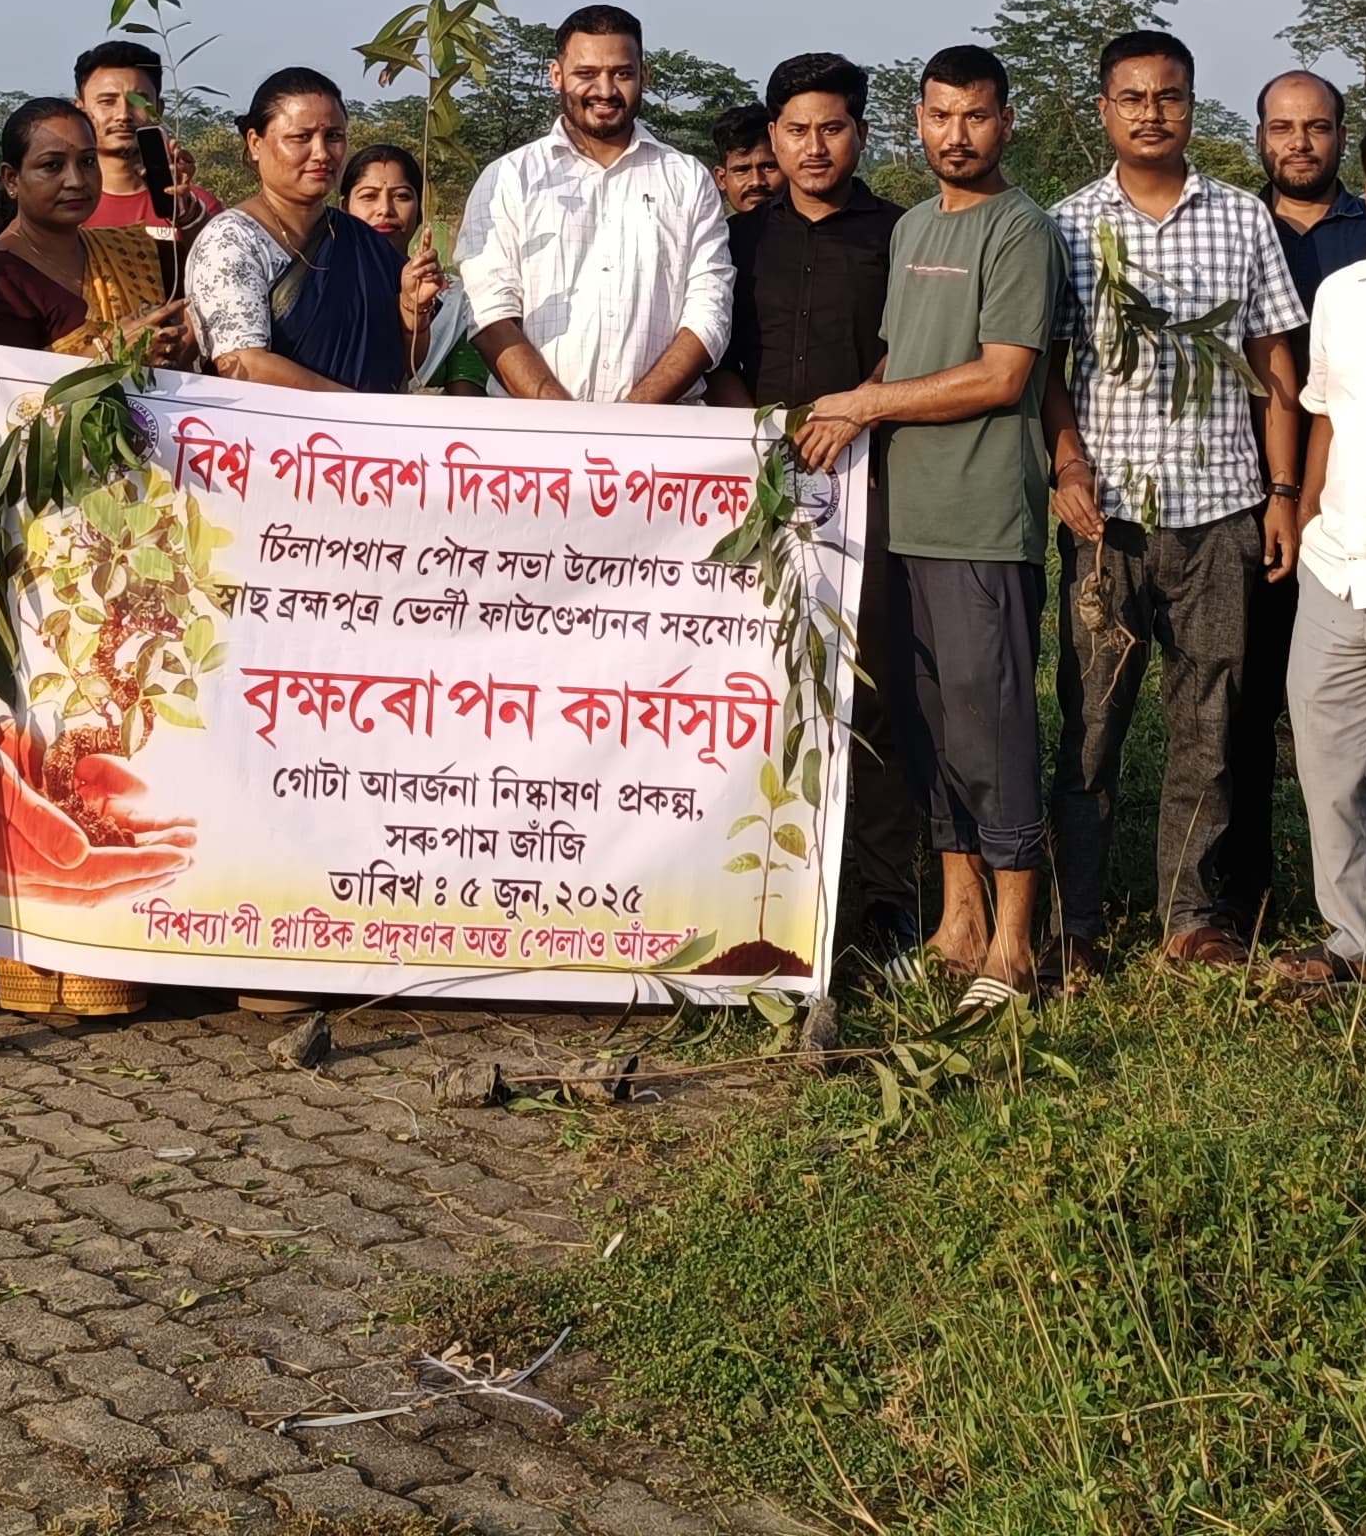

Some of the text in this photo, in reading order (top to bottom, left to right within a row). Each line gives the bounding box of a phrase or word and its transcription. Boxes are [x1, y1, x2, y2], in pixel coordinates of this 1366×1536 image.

[172, 416, 752, 528] বিশ্ব পৰিৱেশ দিৱসৰ উপলক্ষে
[260, 523, 757, 594] চিলাপথাৰ পৌৰ সভা উদ্যোগত আৰু
[393, 588, 469, 630] ভেলী
[273, 757, 351, 801] গোটা
[328, 859, 424, 907] তাৰিখ
[461, 878, 482, 907] ৫
[463, 926, 512, 958] অন্ত
